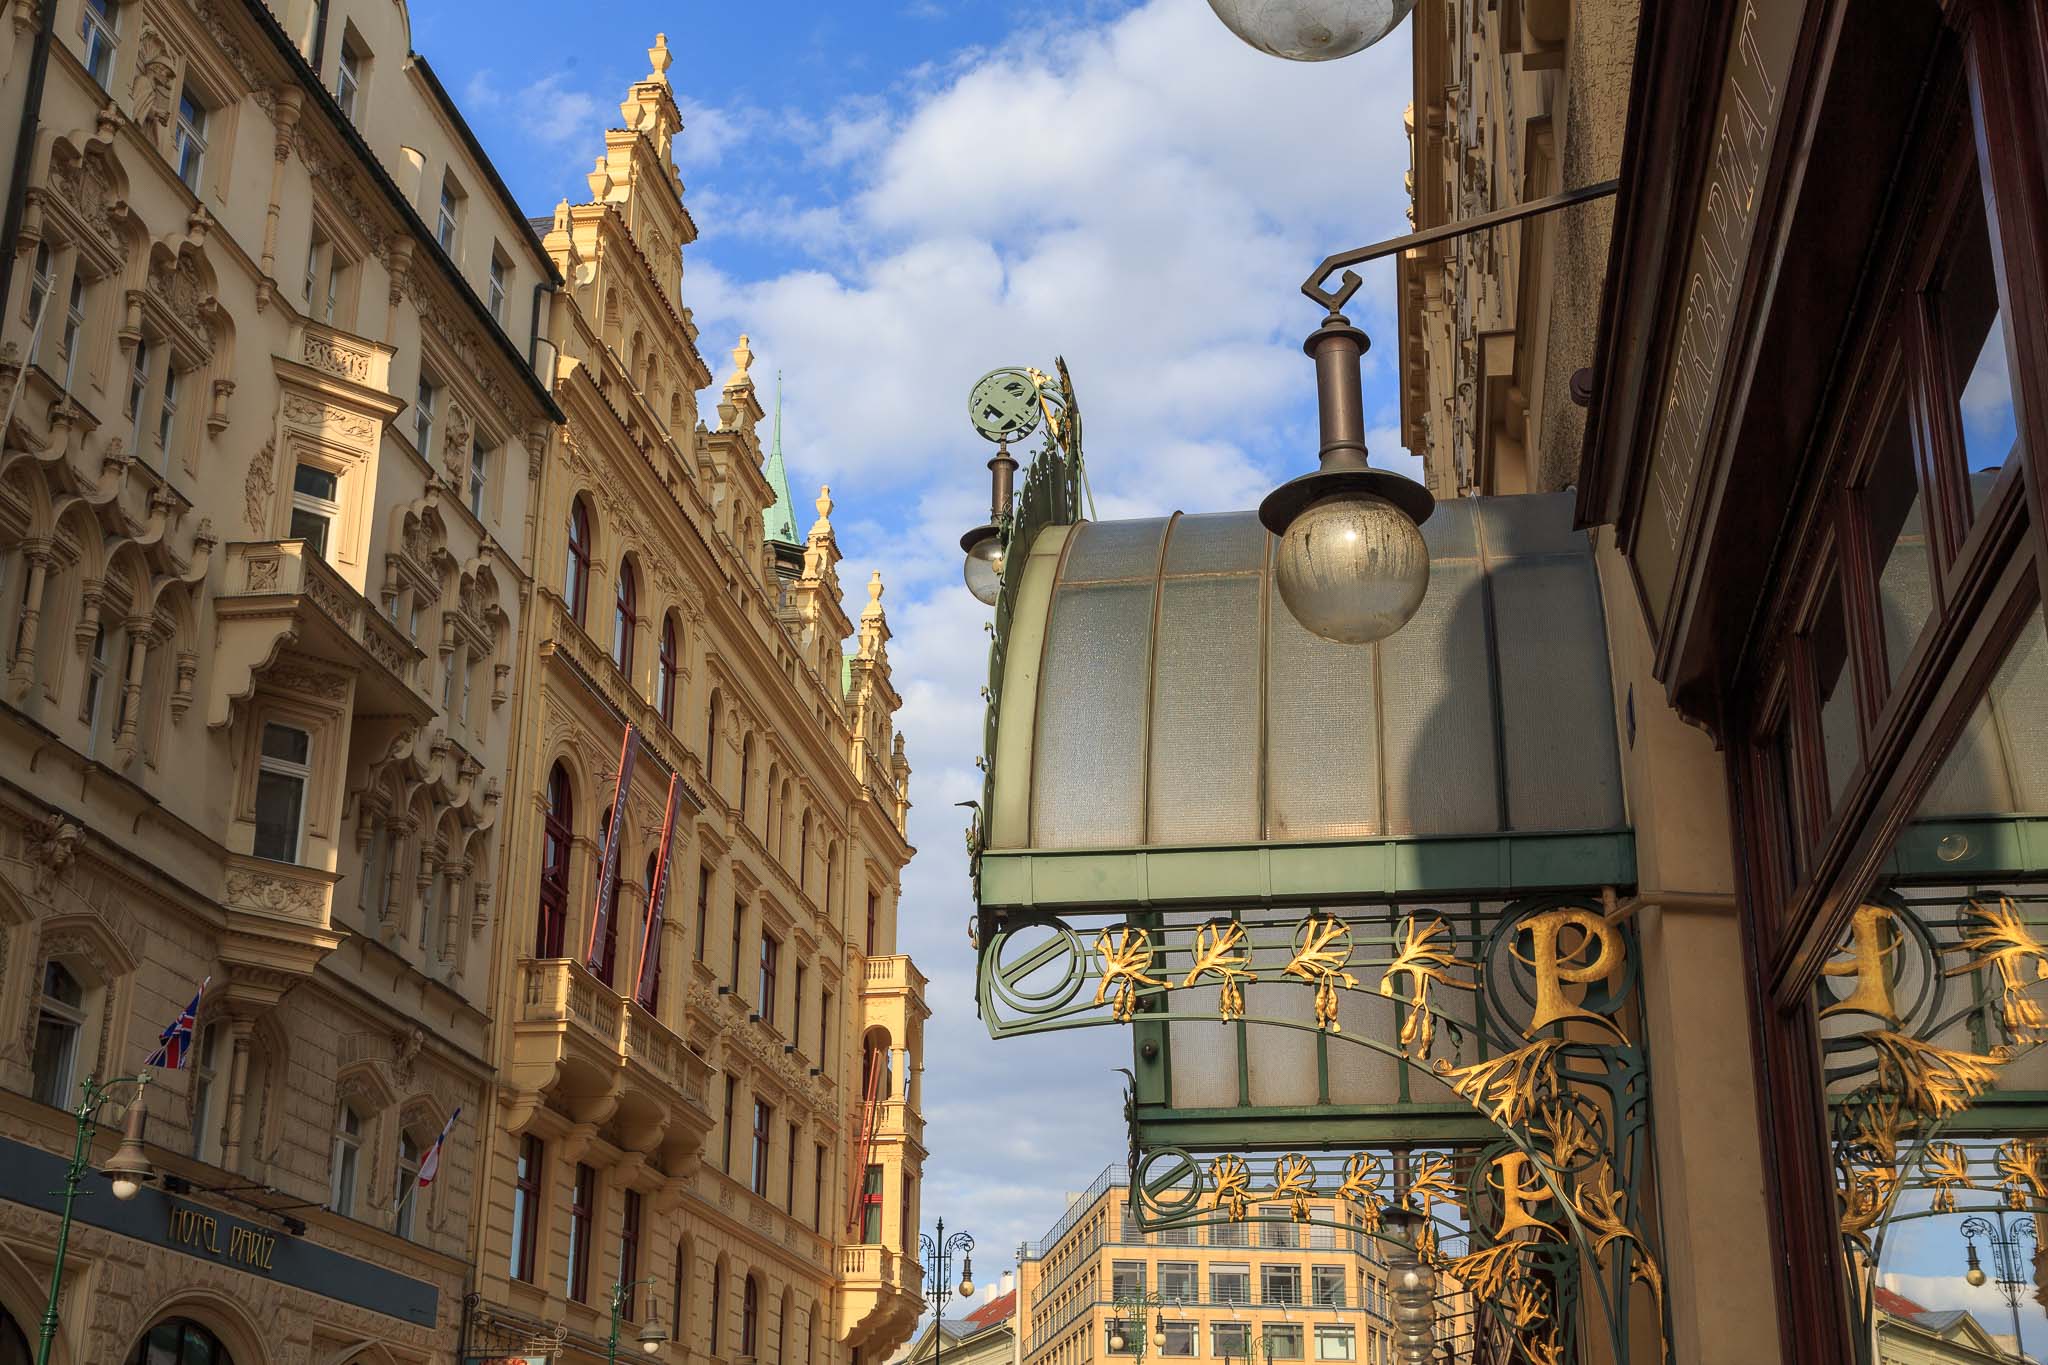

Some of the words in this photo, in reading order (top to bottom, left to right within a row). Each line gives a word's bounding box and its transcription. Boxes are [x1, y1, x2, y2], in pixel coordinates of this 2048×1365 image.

[1655, 0, 1777, 550] АНТИКВАРИАТ
[600, 852, 616, 916] KINGS
[612, 787, 627, 848] COURT
[656, 858, 671, 920] HOTEL
[169, 1206, 221, 1253] HOTEL
